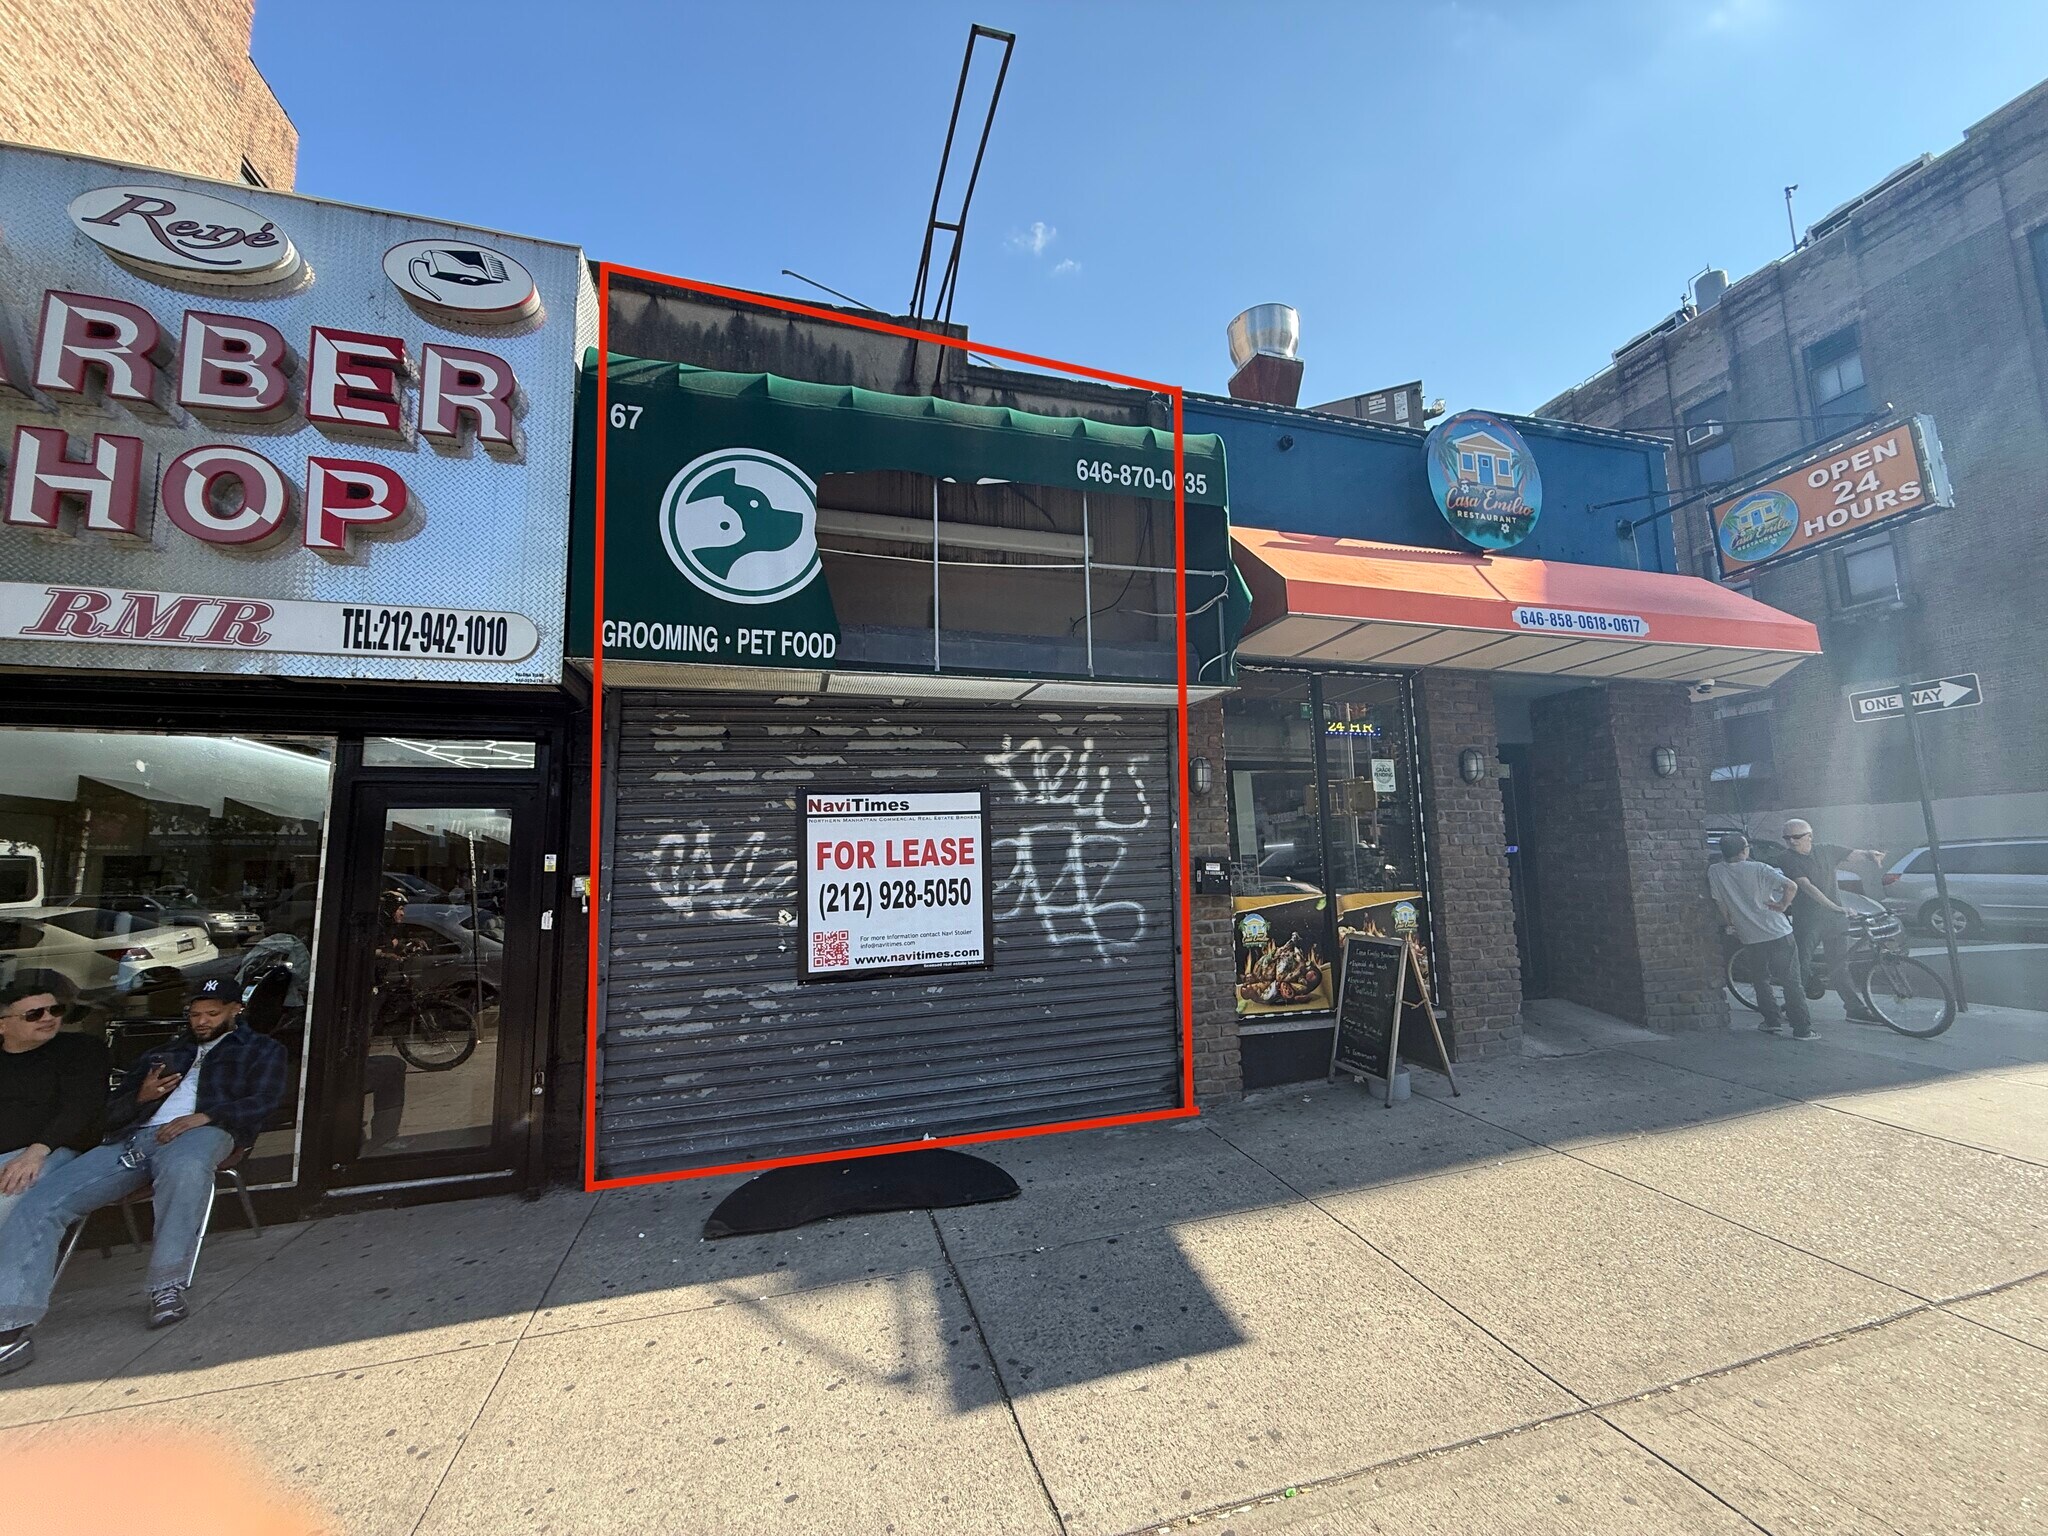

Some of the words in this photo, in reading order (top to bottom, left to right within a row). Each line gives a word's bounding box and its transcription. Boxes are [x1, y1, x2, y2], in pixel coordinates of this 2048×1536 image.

[0, 288, 518, 445] RBER
[610, 402, 644, 430] 67
[1076, 458, 1207, 495] 646-870-035
[1807, 438, 1898, 488] OPEN
[1446, 487, 1481, 509] Casa
[1483, 489, 1535, 516] Emilio
[1832, 469, 1881, 505] 24
[1457, 510, 1517, 524] RESTAURANT
[1803, 480, 1921, 538] HOURS
[1737, 531, 1782, 551] RESTAURANT
[19, 586, 275, 647] RMR
[342, 608, 508, 657] TEL:212-942-1010
[602, 619, 719, 653] GROOMING
[737, 628, 776, 655] PET
[781, 630, 836, 659] FOOD
[1864, 696, 1898, 711] ONE
[808, 798, 910, 813] NaviTimes
[816, 840, 876, 871] FOR
[886, 837, 975, 868] LEASE
[819, 881, 873, 921] (212)
[879, 877, 972, 910] 928-5050
[854, 948, 980, 965] www.navitimes.com
